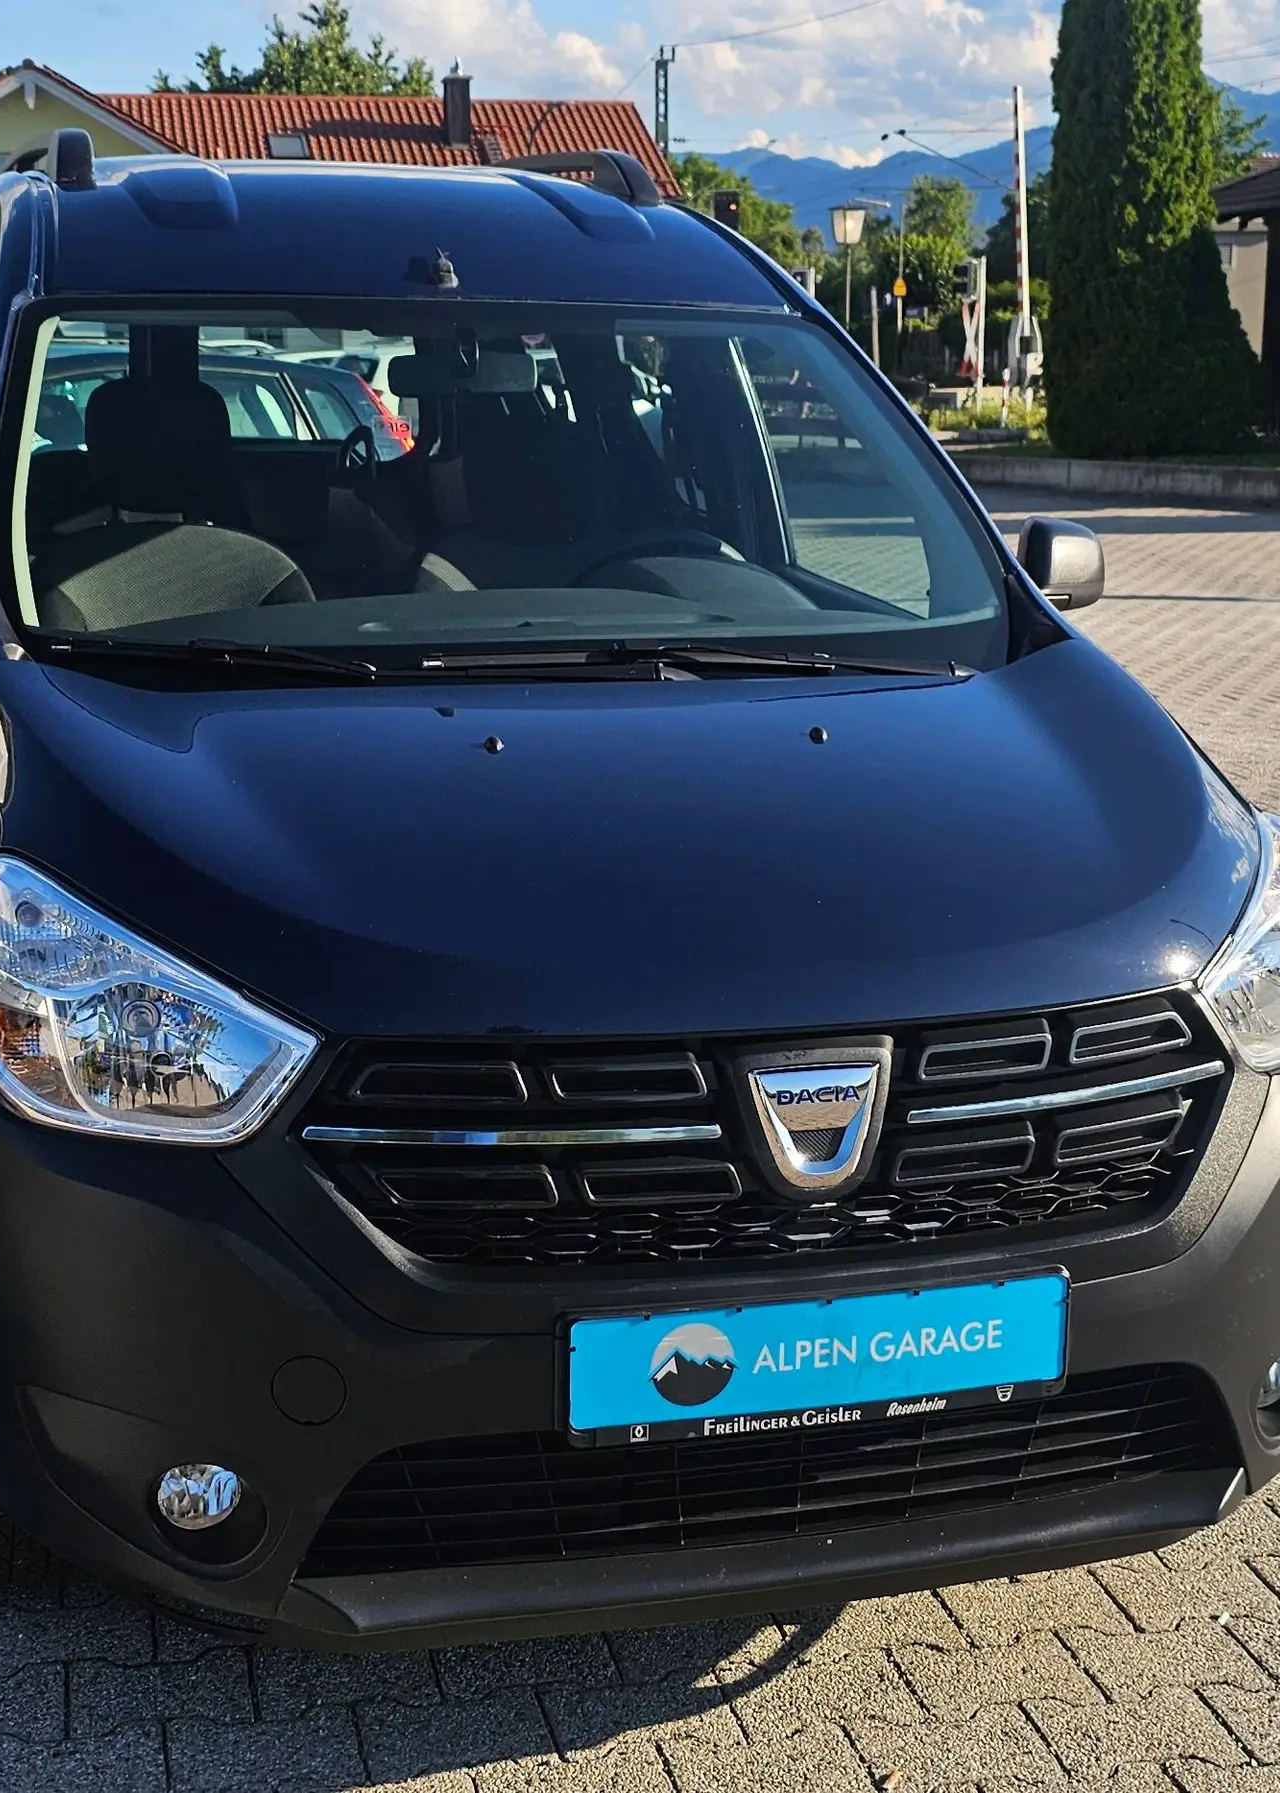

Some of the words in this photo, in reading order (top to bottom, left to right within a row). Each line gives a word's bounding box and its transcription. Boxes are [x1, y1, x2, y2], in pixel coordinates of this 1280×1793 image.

[776, 1085, 860, 1106] DACIA
[752, 1335, 857, 1374] ALPEN
[870, 1319, 1003, 1362] GARAGE
[790, 1416, 801, 1427] &
[886, 1397, 947, 1417] Rosenheim
